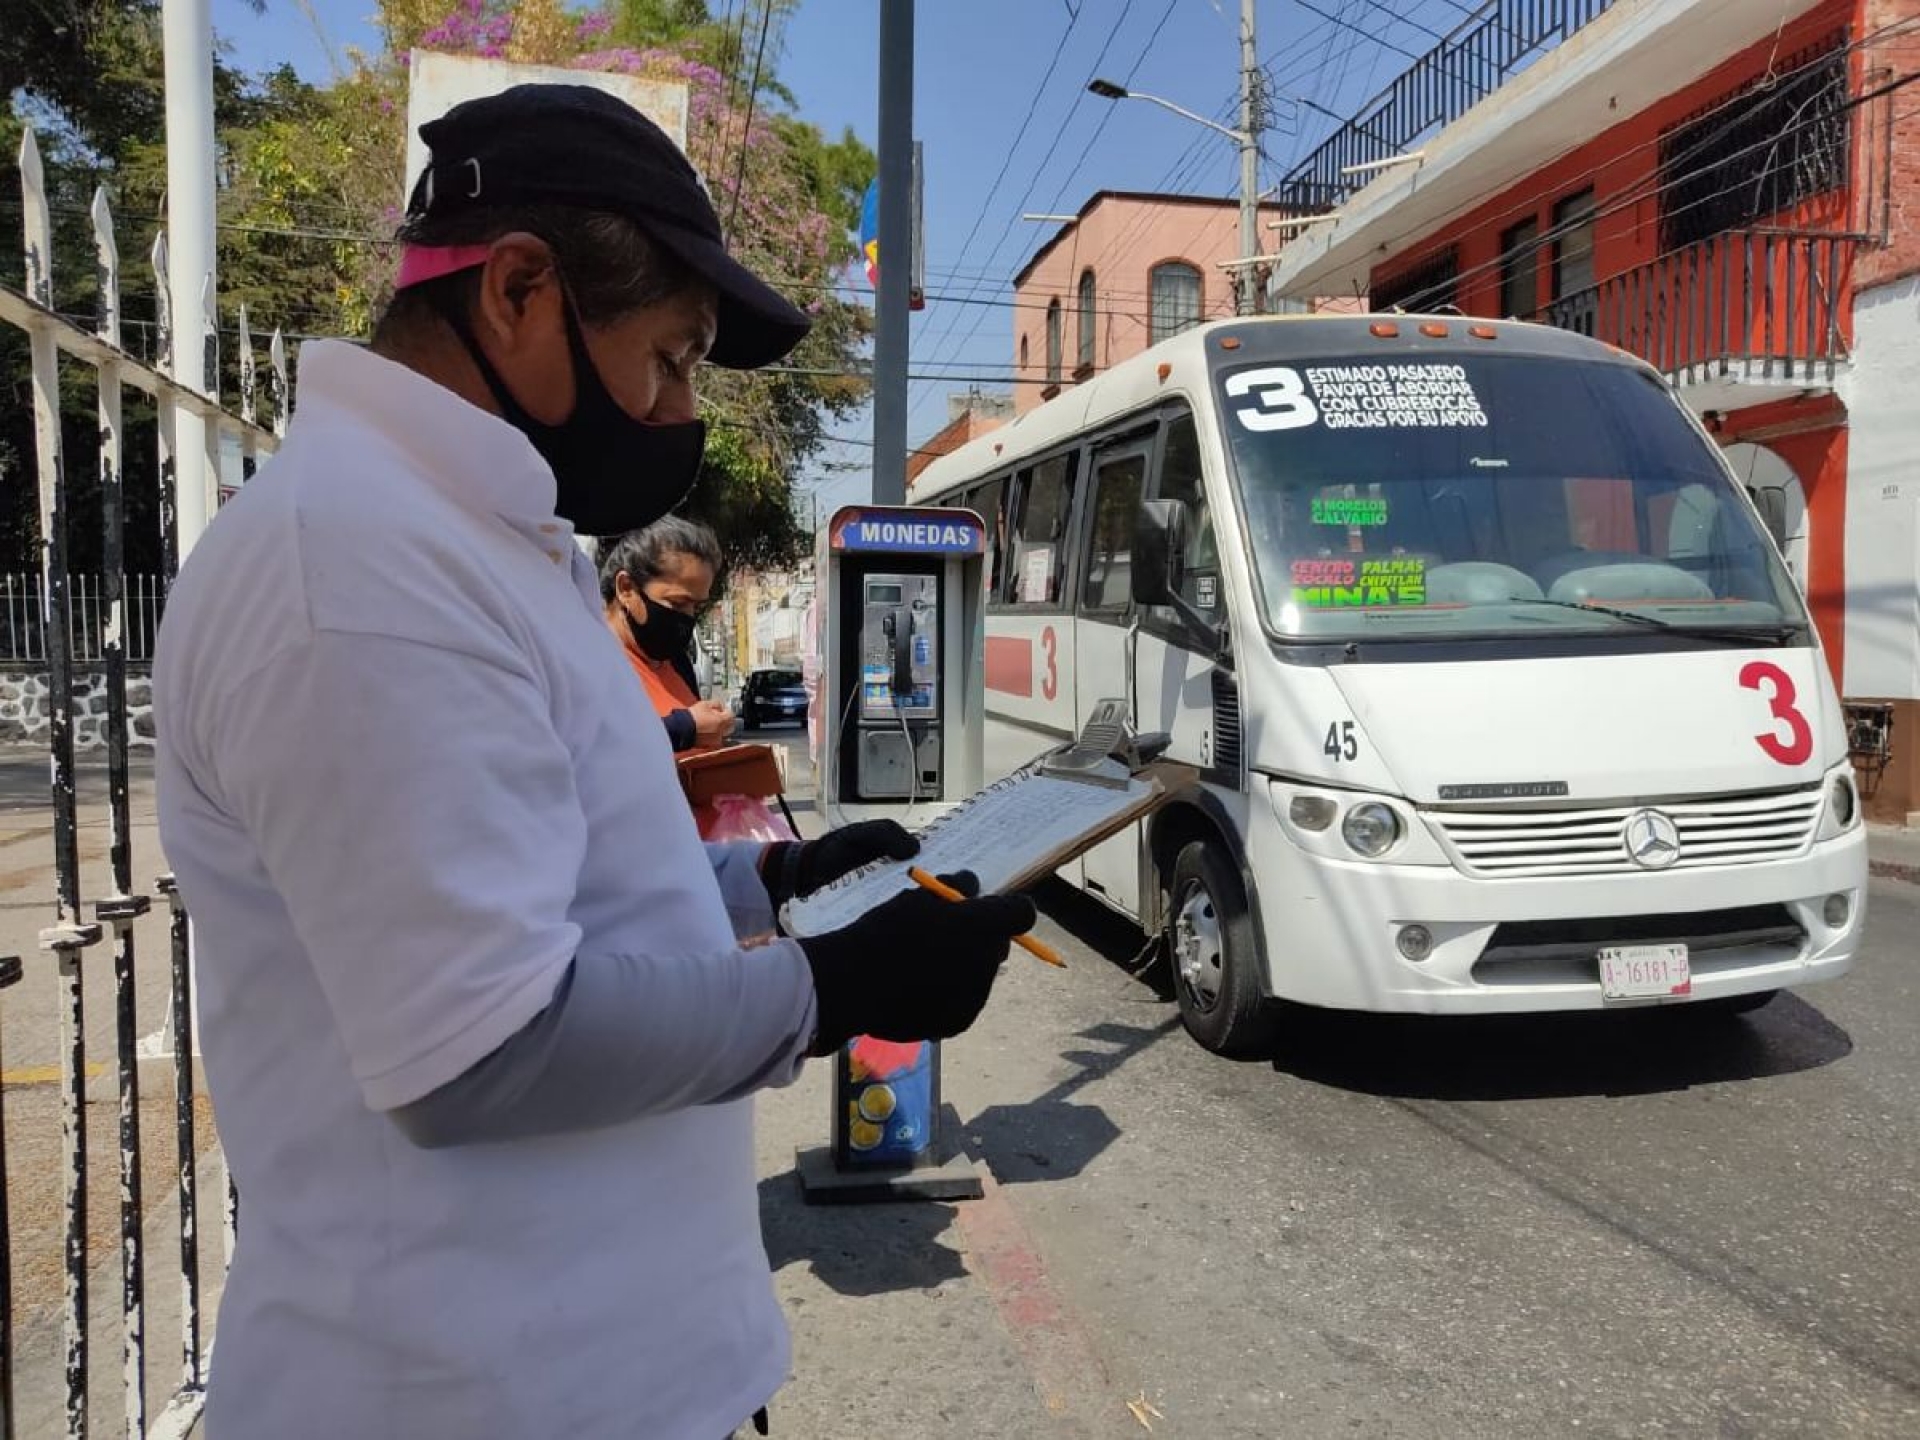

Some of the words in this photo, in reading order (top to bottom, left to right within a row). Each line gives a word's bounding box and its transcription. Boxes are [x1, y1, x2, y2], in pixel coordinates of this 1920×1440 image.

[1305, 367, 1386, 383] ESTIMADO
[1389, 365, 1465, 381] PASAJERO
[1313, 382, 1369, 398] FAVOR
[1371, 382, 1394, 397] DE
[1397, 381, 1473, 396] ABORDAR
[1225, 367, 1318, 432] 3
[1320, 397, 1359, 412] CON
[1362, 396, 1480, 412] CUBREBOCAS
[1324, 411, 1386, 429] GRACIAS
[1388, 411, 1418, 427] POR
[1420, 410, 1437, 426] SU
[1440, 410, 1488, 426] APOYO
[1312, 511, 1387, 525] CALVARIO
[860, 523, 971, 546] MONEDAS
[1362, 560, 1424, 573] PALMAS
[1041, 626, 1057, 701] 3
[1738, 661, 1814, 767] 3
[1324, 721, 1358, 762] 45
